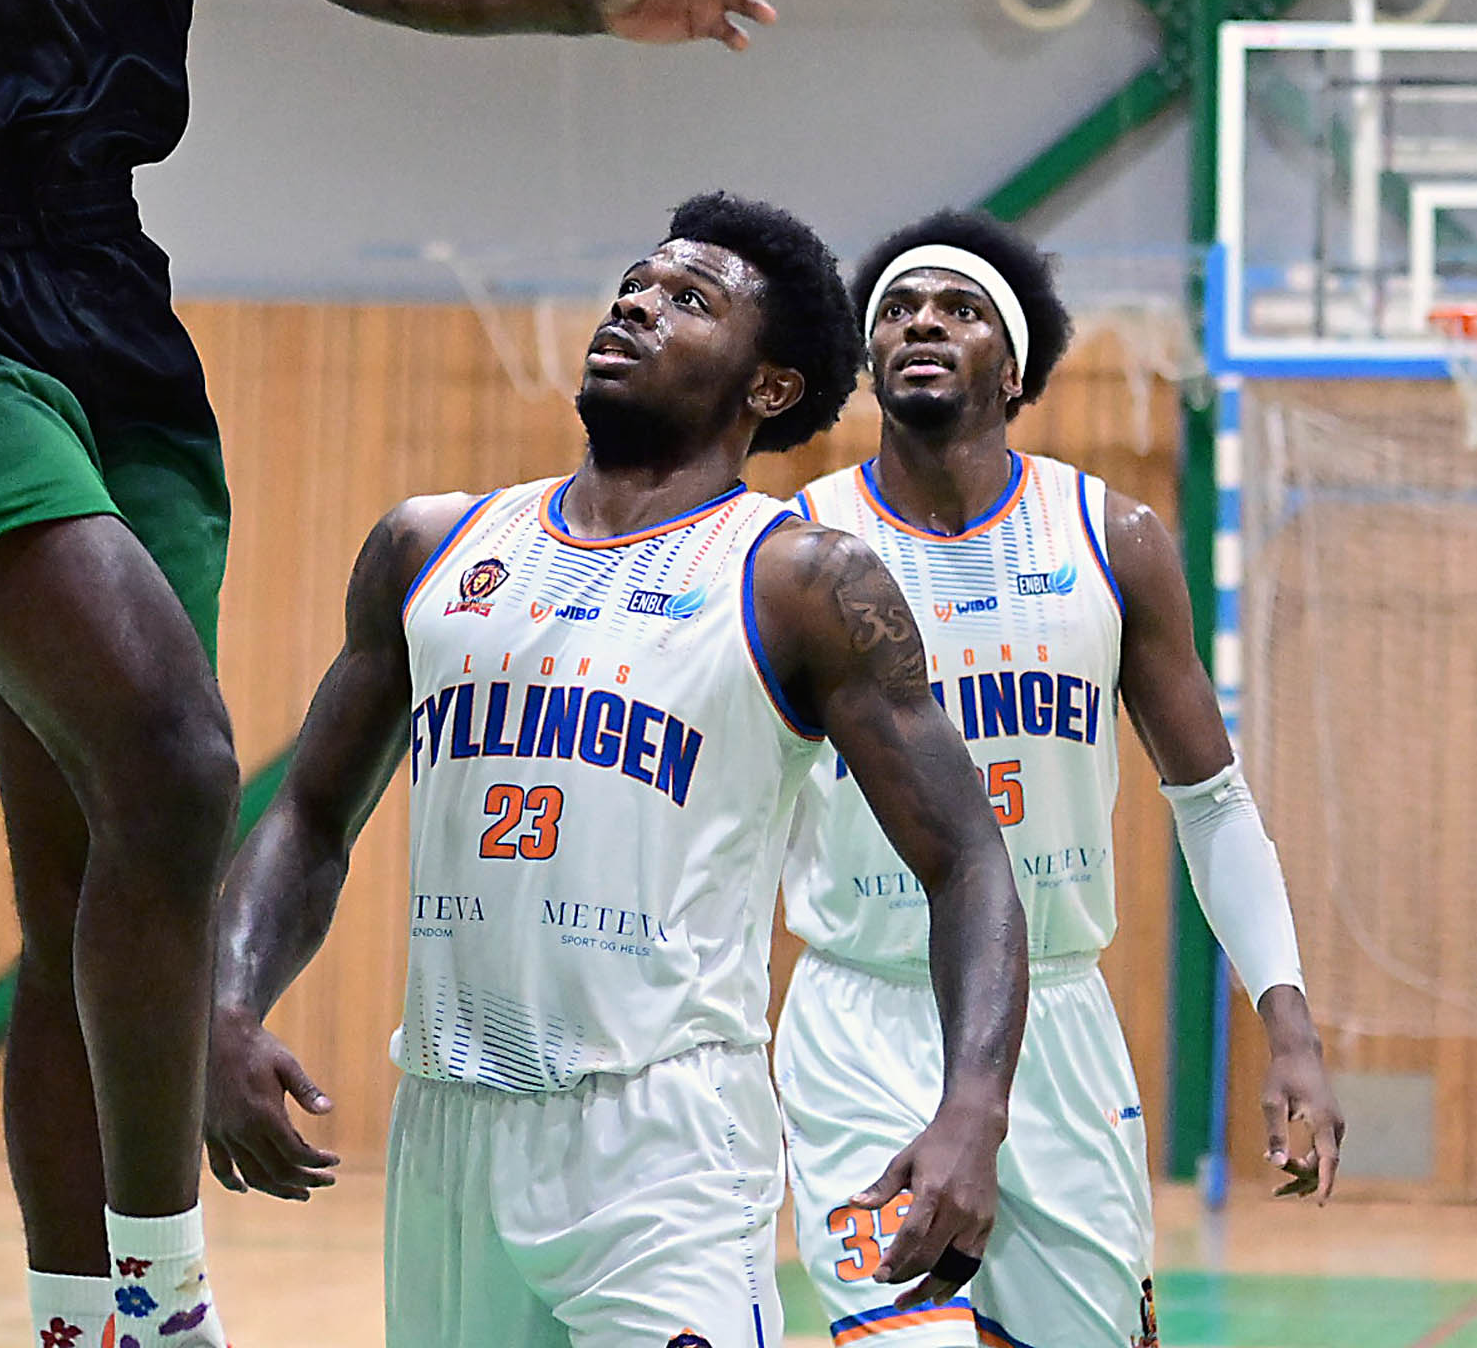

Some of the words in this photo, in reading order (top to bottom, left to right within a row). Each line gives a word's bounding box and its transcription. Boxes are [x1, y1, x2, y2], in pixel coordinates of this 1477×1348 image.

[1019, 576, 1049, 594] ENBL
[555, 606, 601, 621] WIBO
[630, 595, 665, 614] ENBL
[956, 596, 998, 615] WIBO
[463, 652, 631, 684] LIONS
[411, 681, 703, 808] FYLLINGEN
[976, 759, 1025, 828] 5
[478, 783, 565, 861] 23
[540, 899, 669, 943] METEVA
[560, 934, 597, 948] SPORT
[599, 940, 617, 952] OG
